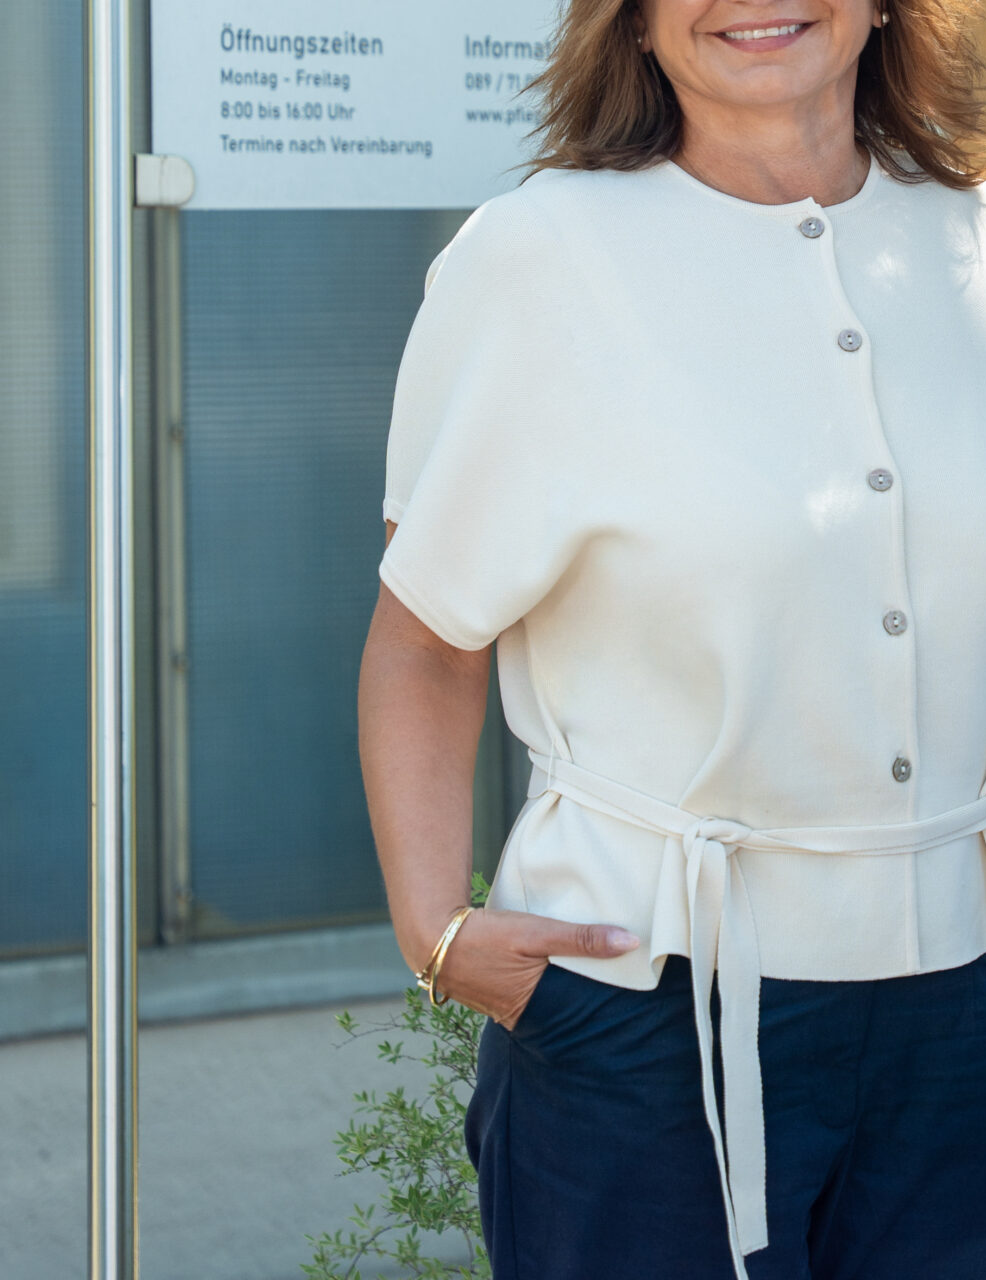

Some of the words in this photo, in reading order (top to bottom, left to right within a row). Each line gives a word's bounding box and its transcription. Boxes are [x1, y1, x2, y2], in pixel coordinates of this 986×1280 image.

[220, 23, 384, 59] Öffnungszeiten
[464, 35, 551, 59] Informat
[220, 68, 279, 91] Montag
[296, 69, 351, 92] Freitag
[258, 101, 281, 120] bis
[327, 102, 356, 121] Uhr
[219, 133, 284, 154] Termine
[288, 136, 326, 154] nach
[330, 136, 434, 160] Vereinbarung
